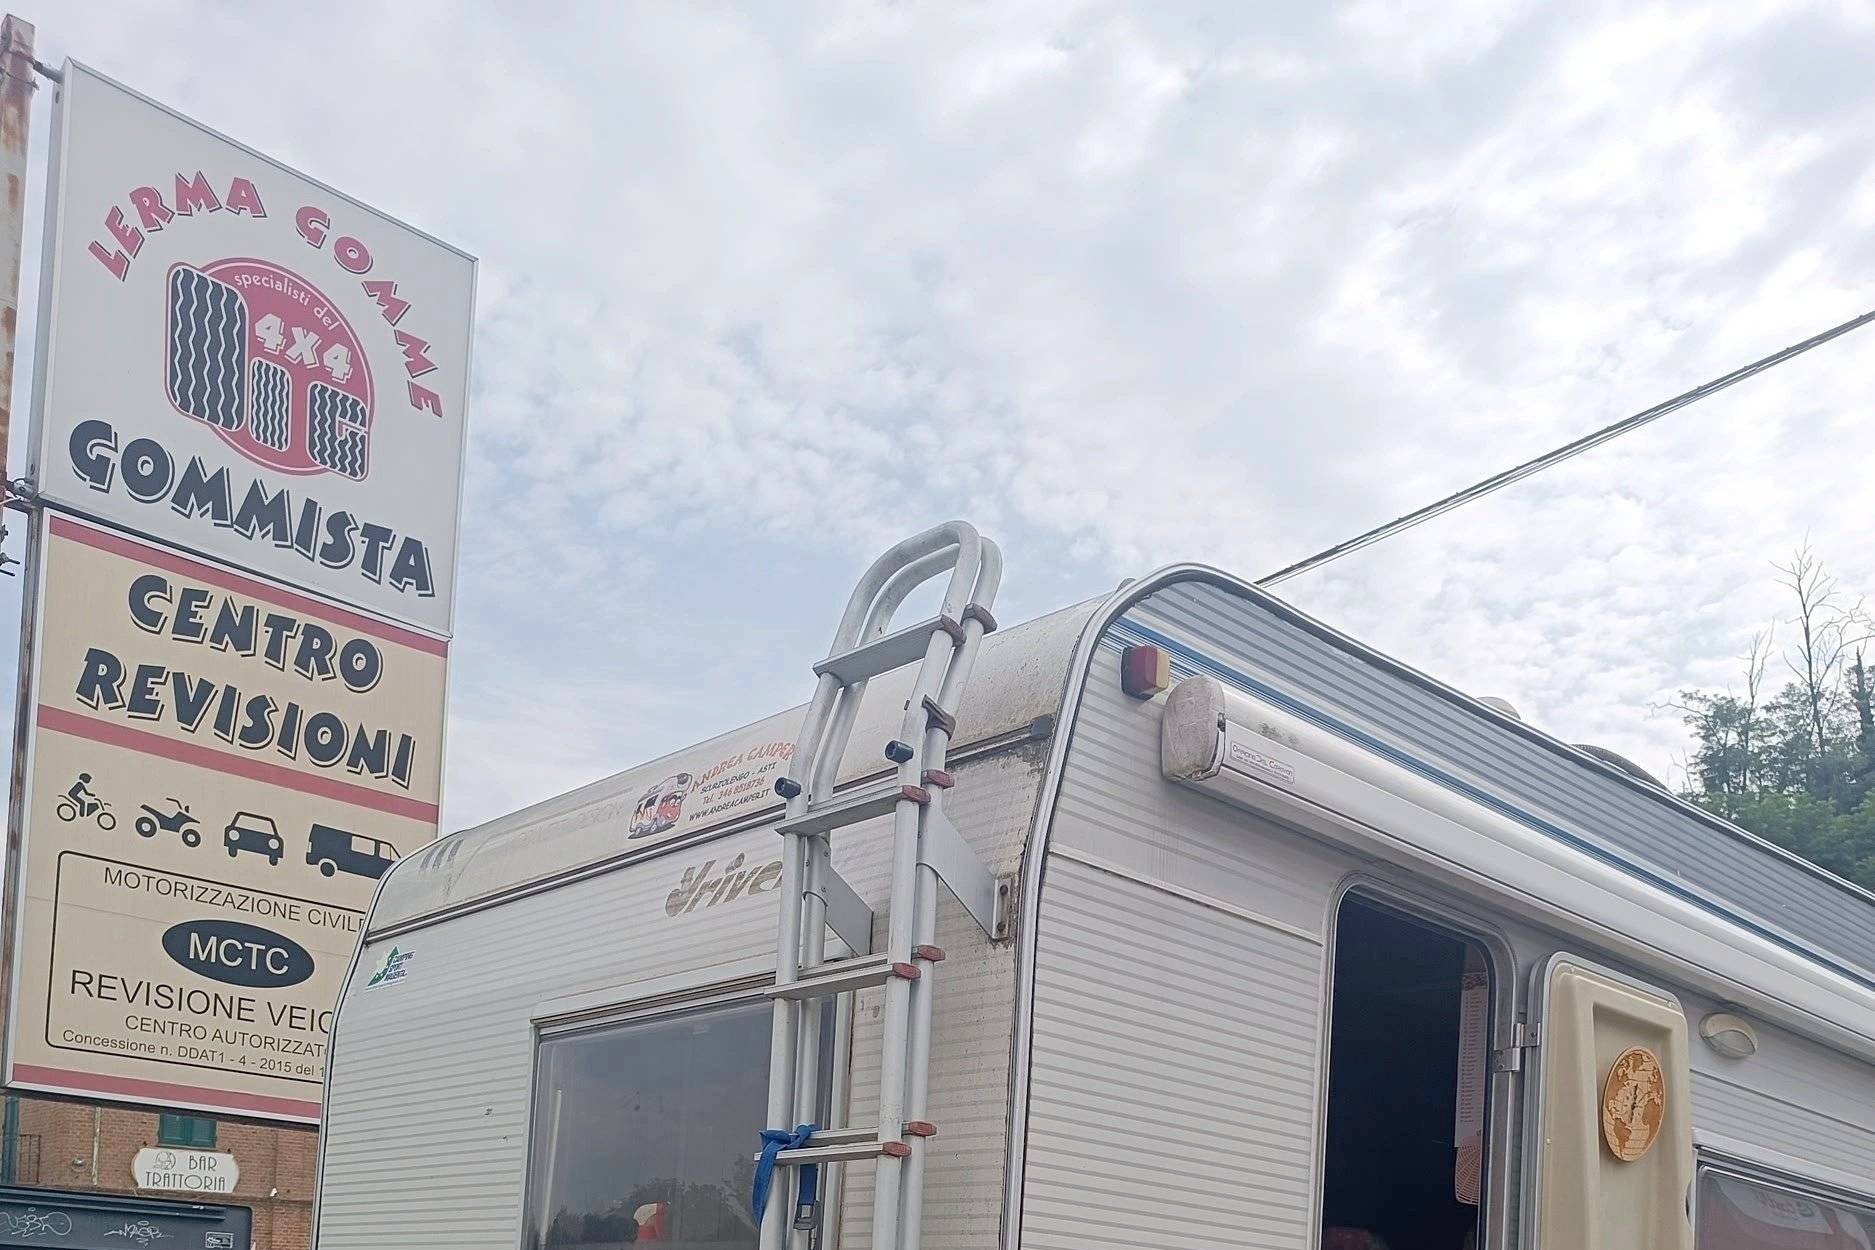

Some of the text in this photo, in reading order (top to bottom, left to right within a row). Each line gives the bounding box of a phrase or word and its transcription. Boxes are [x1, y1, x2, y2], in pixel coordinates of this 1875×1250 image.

[88, 170, 443, 417] LERMA GOMME
[234, 274, 340, 331] specialisti del
[69, 419, 436, 598] GOMMISTA
[128, 575, 383, 692] CENTRO
[76, 647, 416, 789] REVISIONI
[690, 754, 743, 793] ANDREA
[104, 867, 301, 922] MOTORIZZAZIONE
[189, 932, 289, 975] MCTC
[70, 969, 332, 1034] REVISIONE VEIC
[63, 1029, 156, 1055] Concessione
[160, 1045, 172, 1057] n.
[178, 1045, 225, 1064] DDAT1
[238, 1055, 247, 1066] 4
[260, 1057, 291, 1073] 2015
[295, 1062, 314, 1076] del
[125, 1015, 327, 1058] CENTRO AUTORIZZAT
[145, 1170, 226, 1191] TRATTORIA
[188, 1155, 217, 1171] BAR
